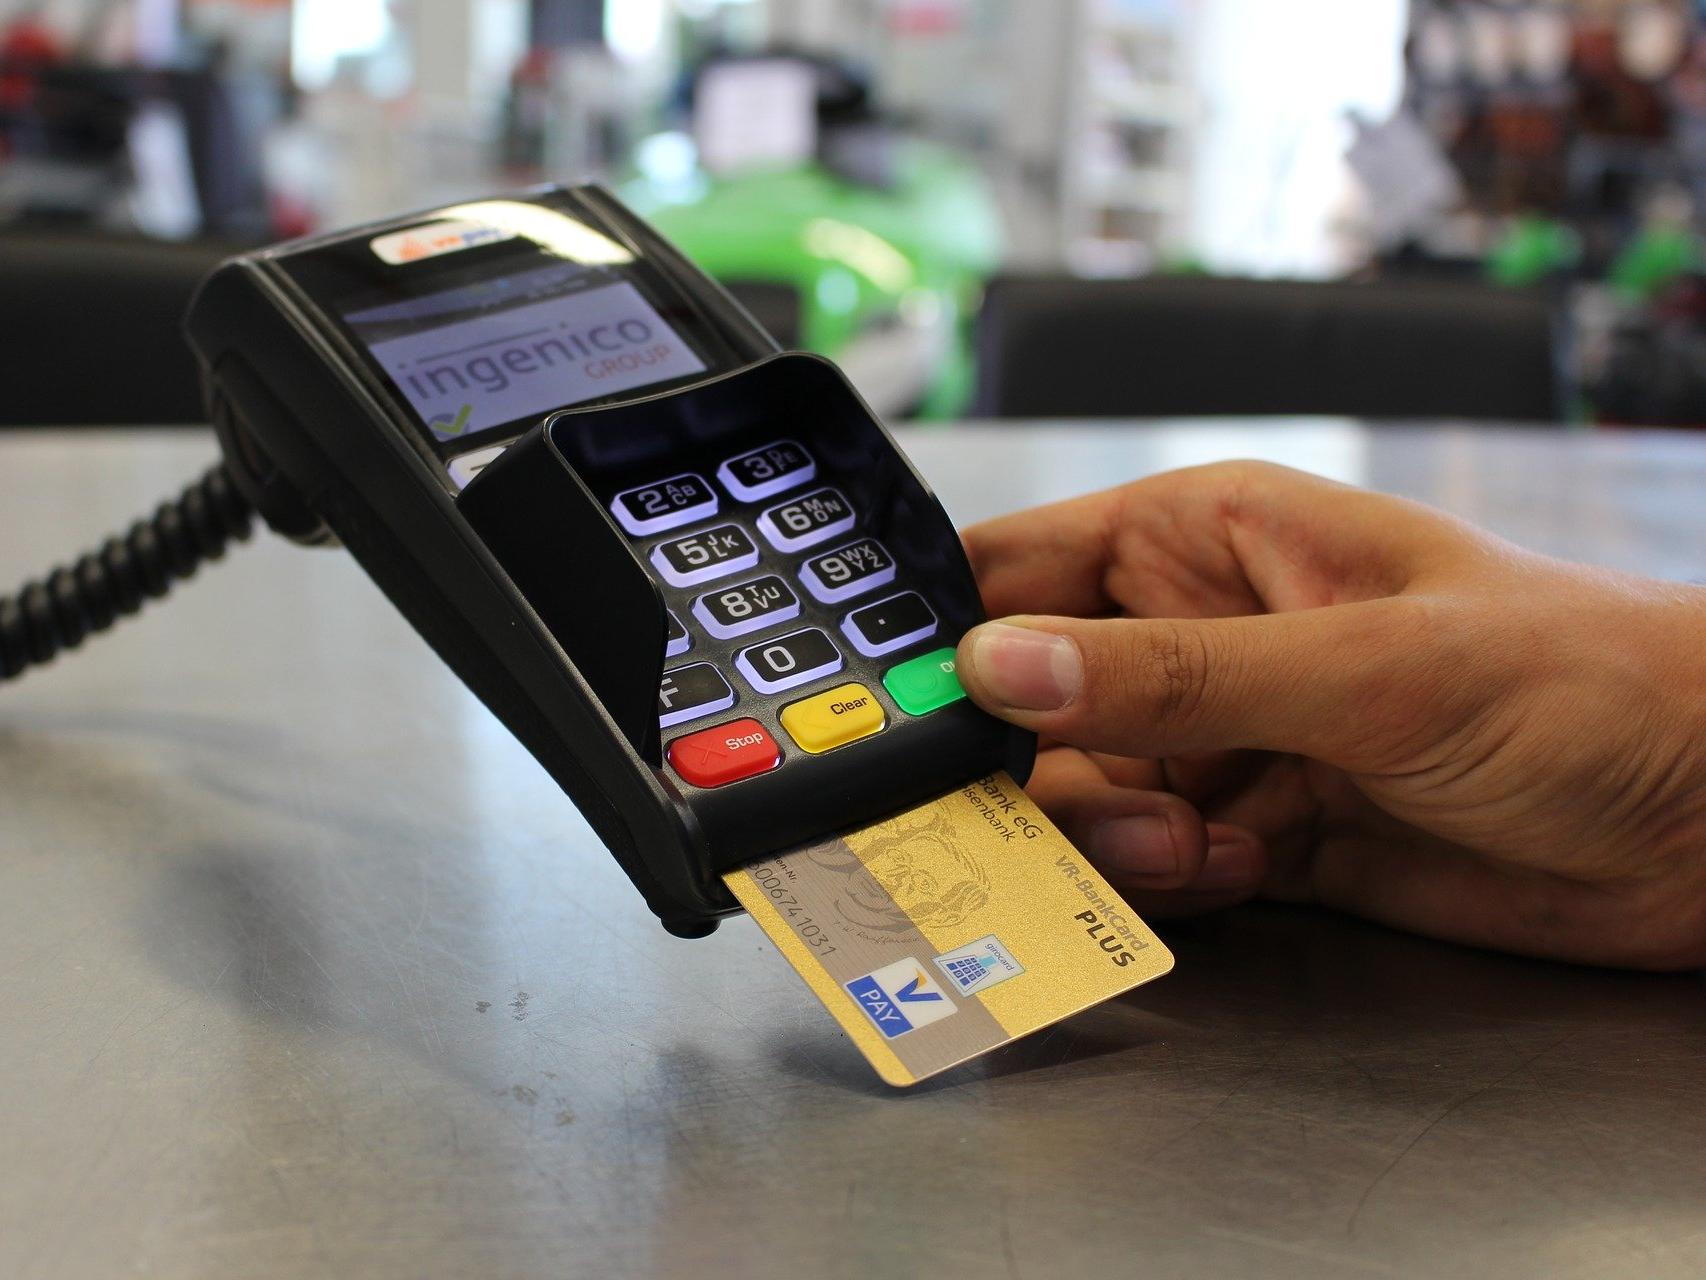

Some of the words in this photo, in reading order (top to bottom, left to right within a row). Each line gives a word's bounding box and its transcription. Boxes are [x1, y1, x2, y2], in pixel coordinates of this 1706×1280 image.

[399, 318, 653, 400] ingenico
[583, 344, 674, 380] GROUP
[743, 456, 775, 479] 3
[637, 489, 669, 515] 2
[781, 507, 811, 532] 6
[676, 532, 710, 565] 5
[820, 557, 851, 583] 9
[720, 592, 753, 619] 8
[940, 660, 956, 673] O
[830, 695, 869, 717] Clear
[725, 731, 765, 752] Stop
[1013, 816, 1043, 839] eG
[1055, 854, 1150, 952] VR-BankCard
[1074, 910, 1136, 967] PLUS
[985, 943, 1015, 971] girocard
[860, 989, 902, 1022] PAY
